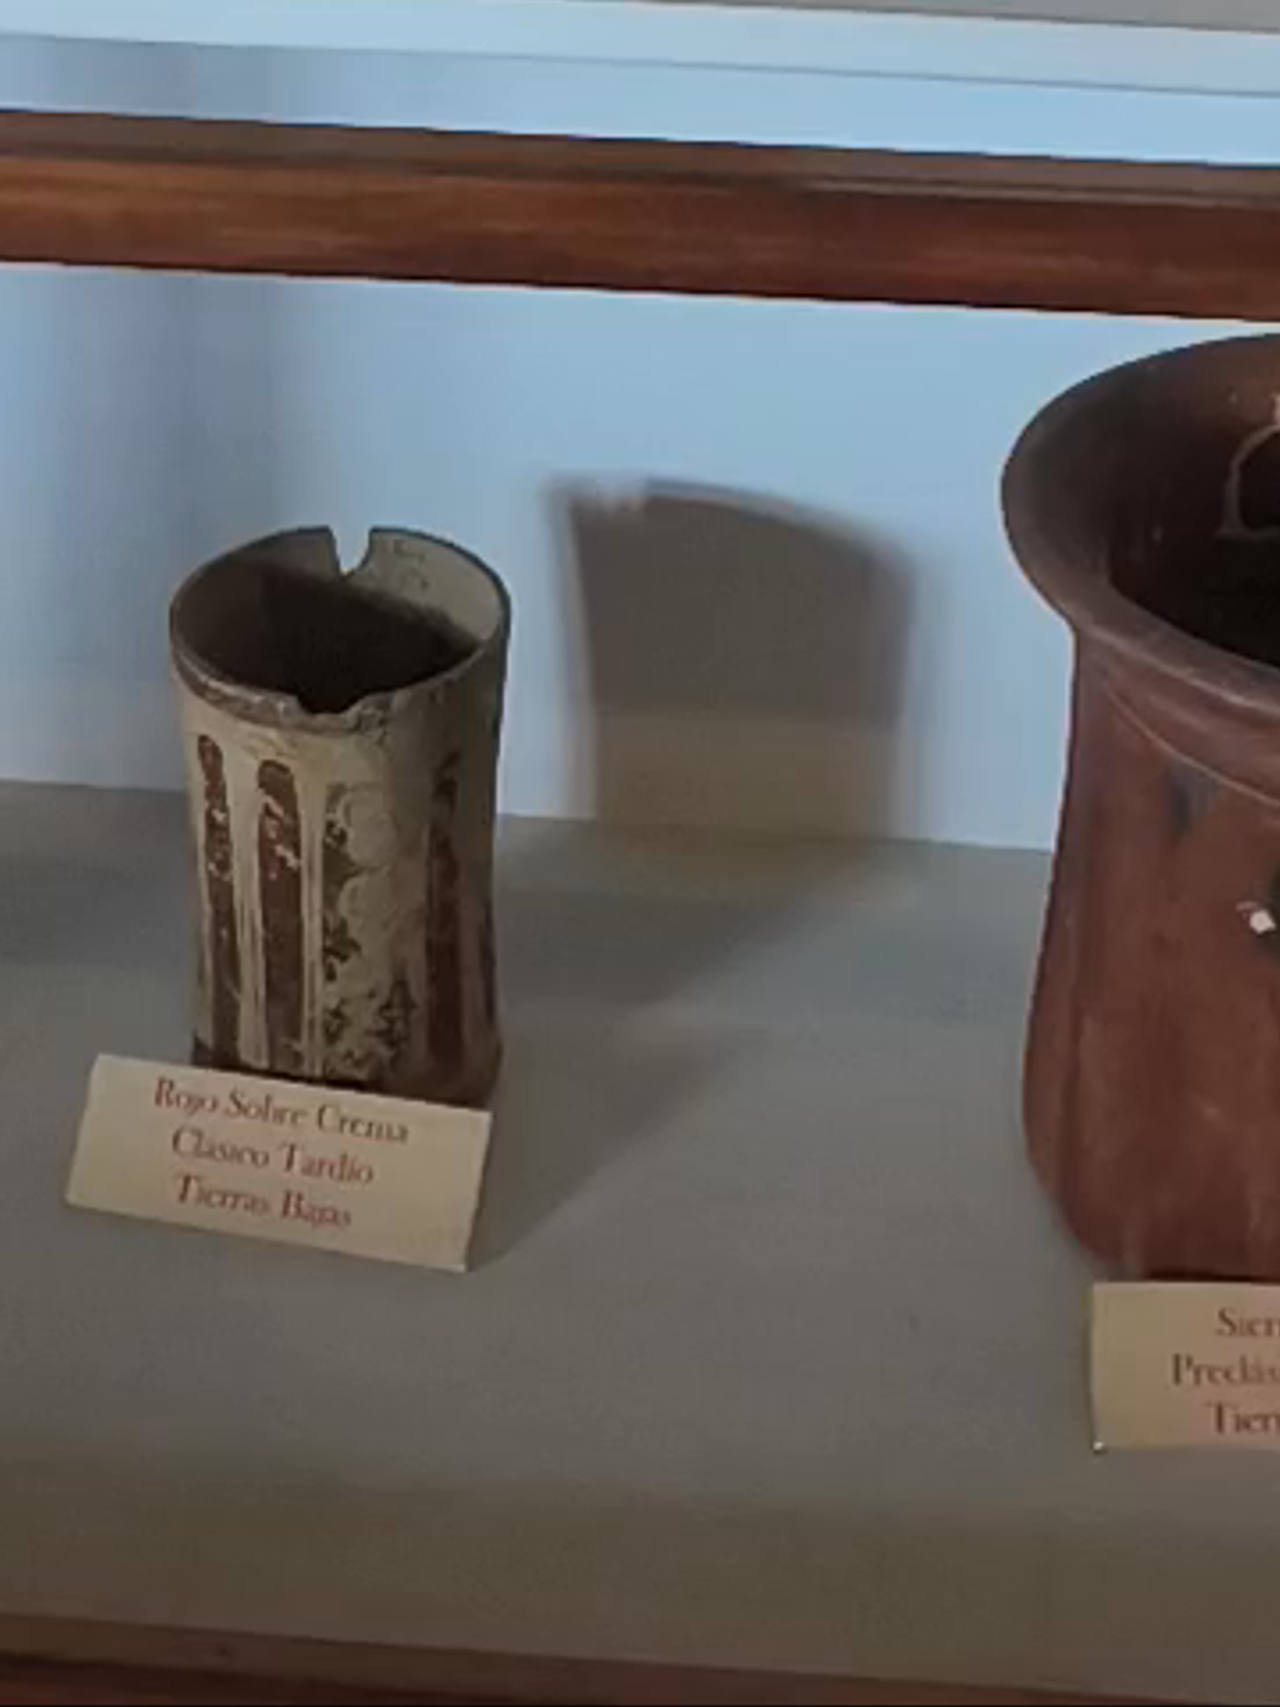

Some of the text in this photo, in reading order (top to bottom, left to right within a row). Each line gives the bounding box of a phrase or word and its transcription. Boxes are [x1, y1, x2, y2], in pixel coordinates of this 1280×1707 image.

[154, 1077, 409, 1144] Rojo Sobre Crema
[176, 1174, 352, 1230] Tierras Bajas
